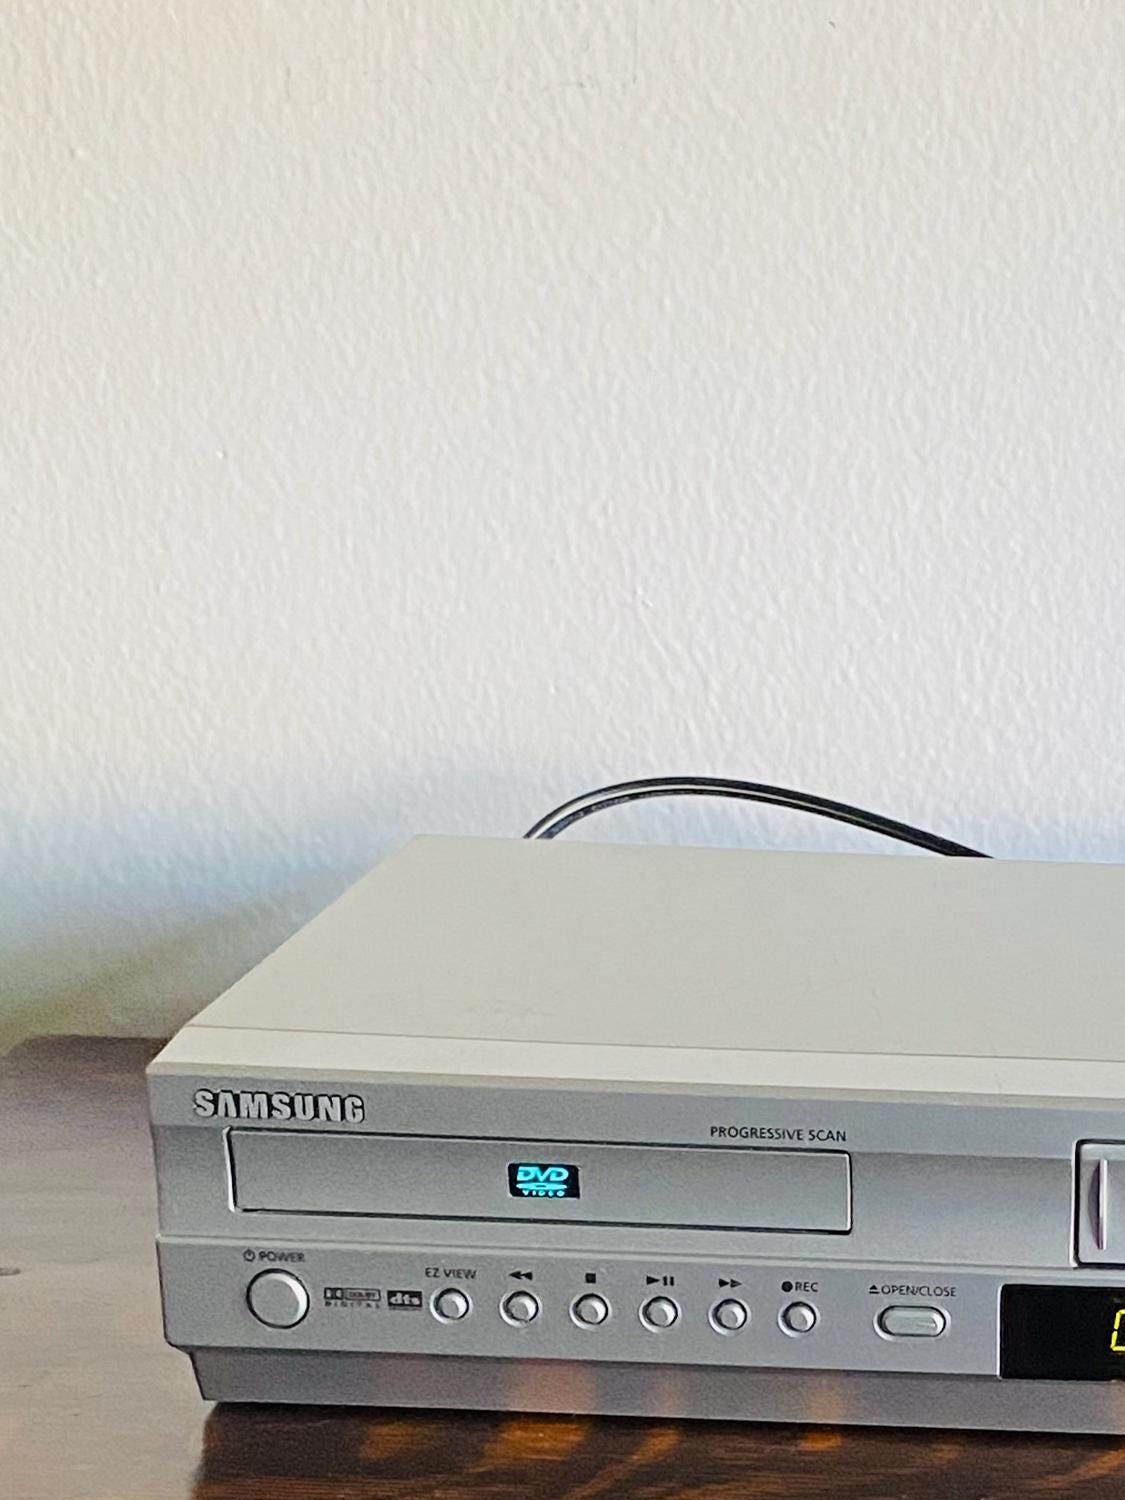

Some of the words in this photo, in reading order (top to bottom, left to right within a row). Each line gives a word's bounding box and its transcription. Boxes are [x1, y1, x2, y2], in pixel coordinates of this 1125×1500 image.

[193, 1089, 366, 1124] SAMSUNG
[710, 1126, 804, 1141] PROGRESSIVE
[808, 1129, 847, 1143] SCAN
[516, 1166, 569, 1181] DVD
[258, 1250, 305, 1263] POWER
[425, 1267, 440, 1278] EZ
[444, 1268, 477, 1280] VIEW
[795, 1281, 818, 1293] REC
[881, 1284, 957, 1298] OPEN/CLOSE
